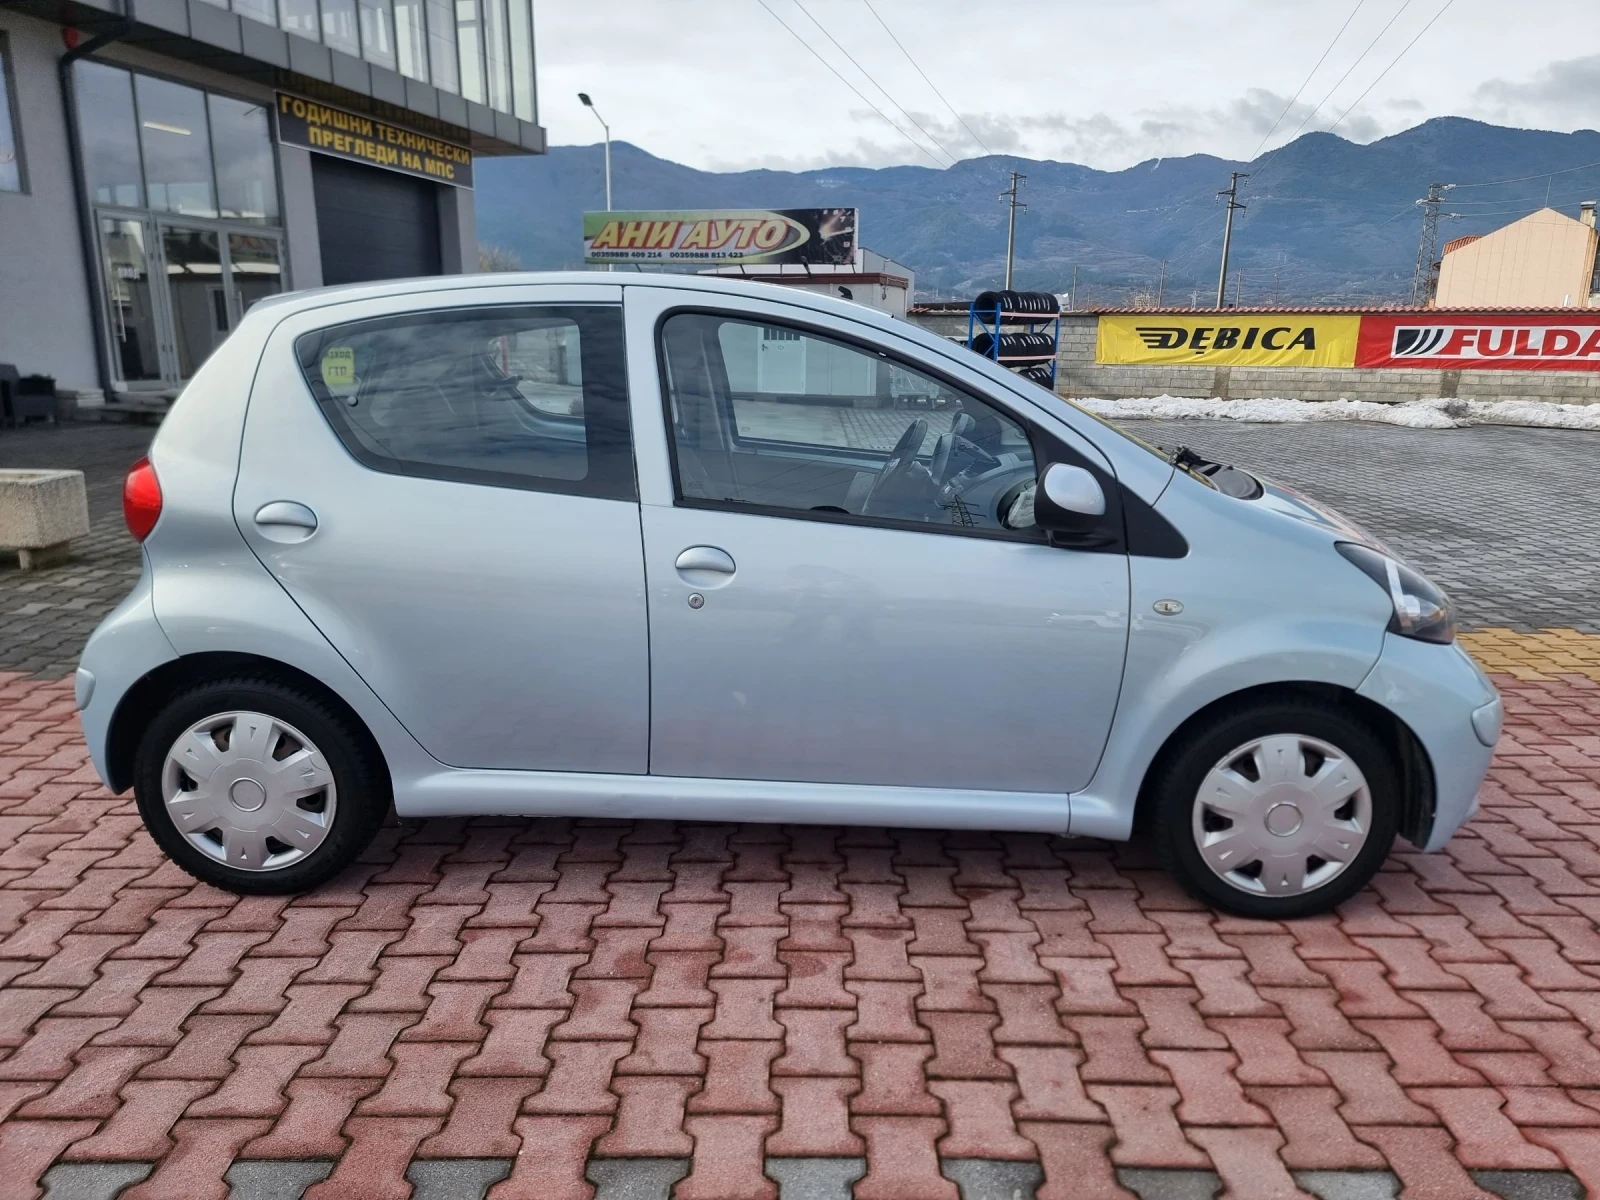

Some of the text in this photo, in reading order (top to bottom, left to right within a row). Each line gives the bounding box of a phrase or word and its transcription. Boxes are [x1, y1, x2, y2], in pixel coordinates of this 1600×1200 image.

[280, 95, 373, 138] ГОДИШНИ
[376, 125, 470, 166] ТЕХНИЧЕСКИ
[308, 127, 455, 179] ПРЕГЛЕДИ НА МПС
[590, 219, 791, 250] АНИ АУТО
[728, 251, 744, 259] 423
[1135, 326, 1316, 355] DĘBICA
